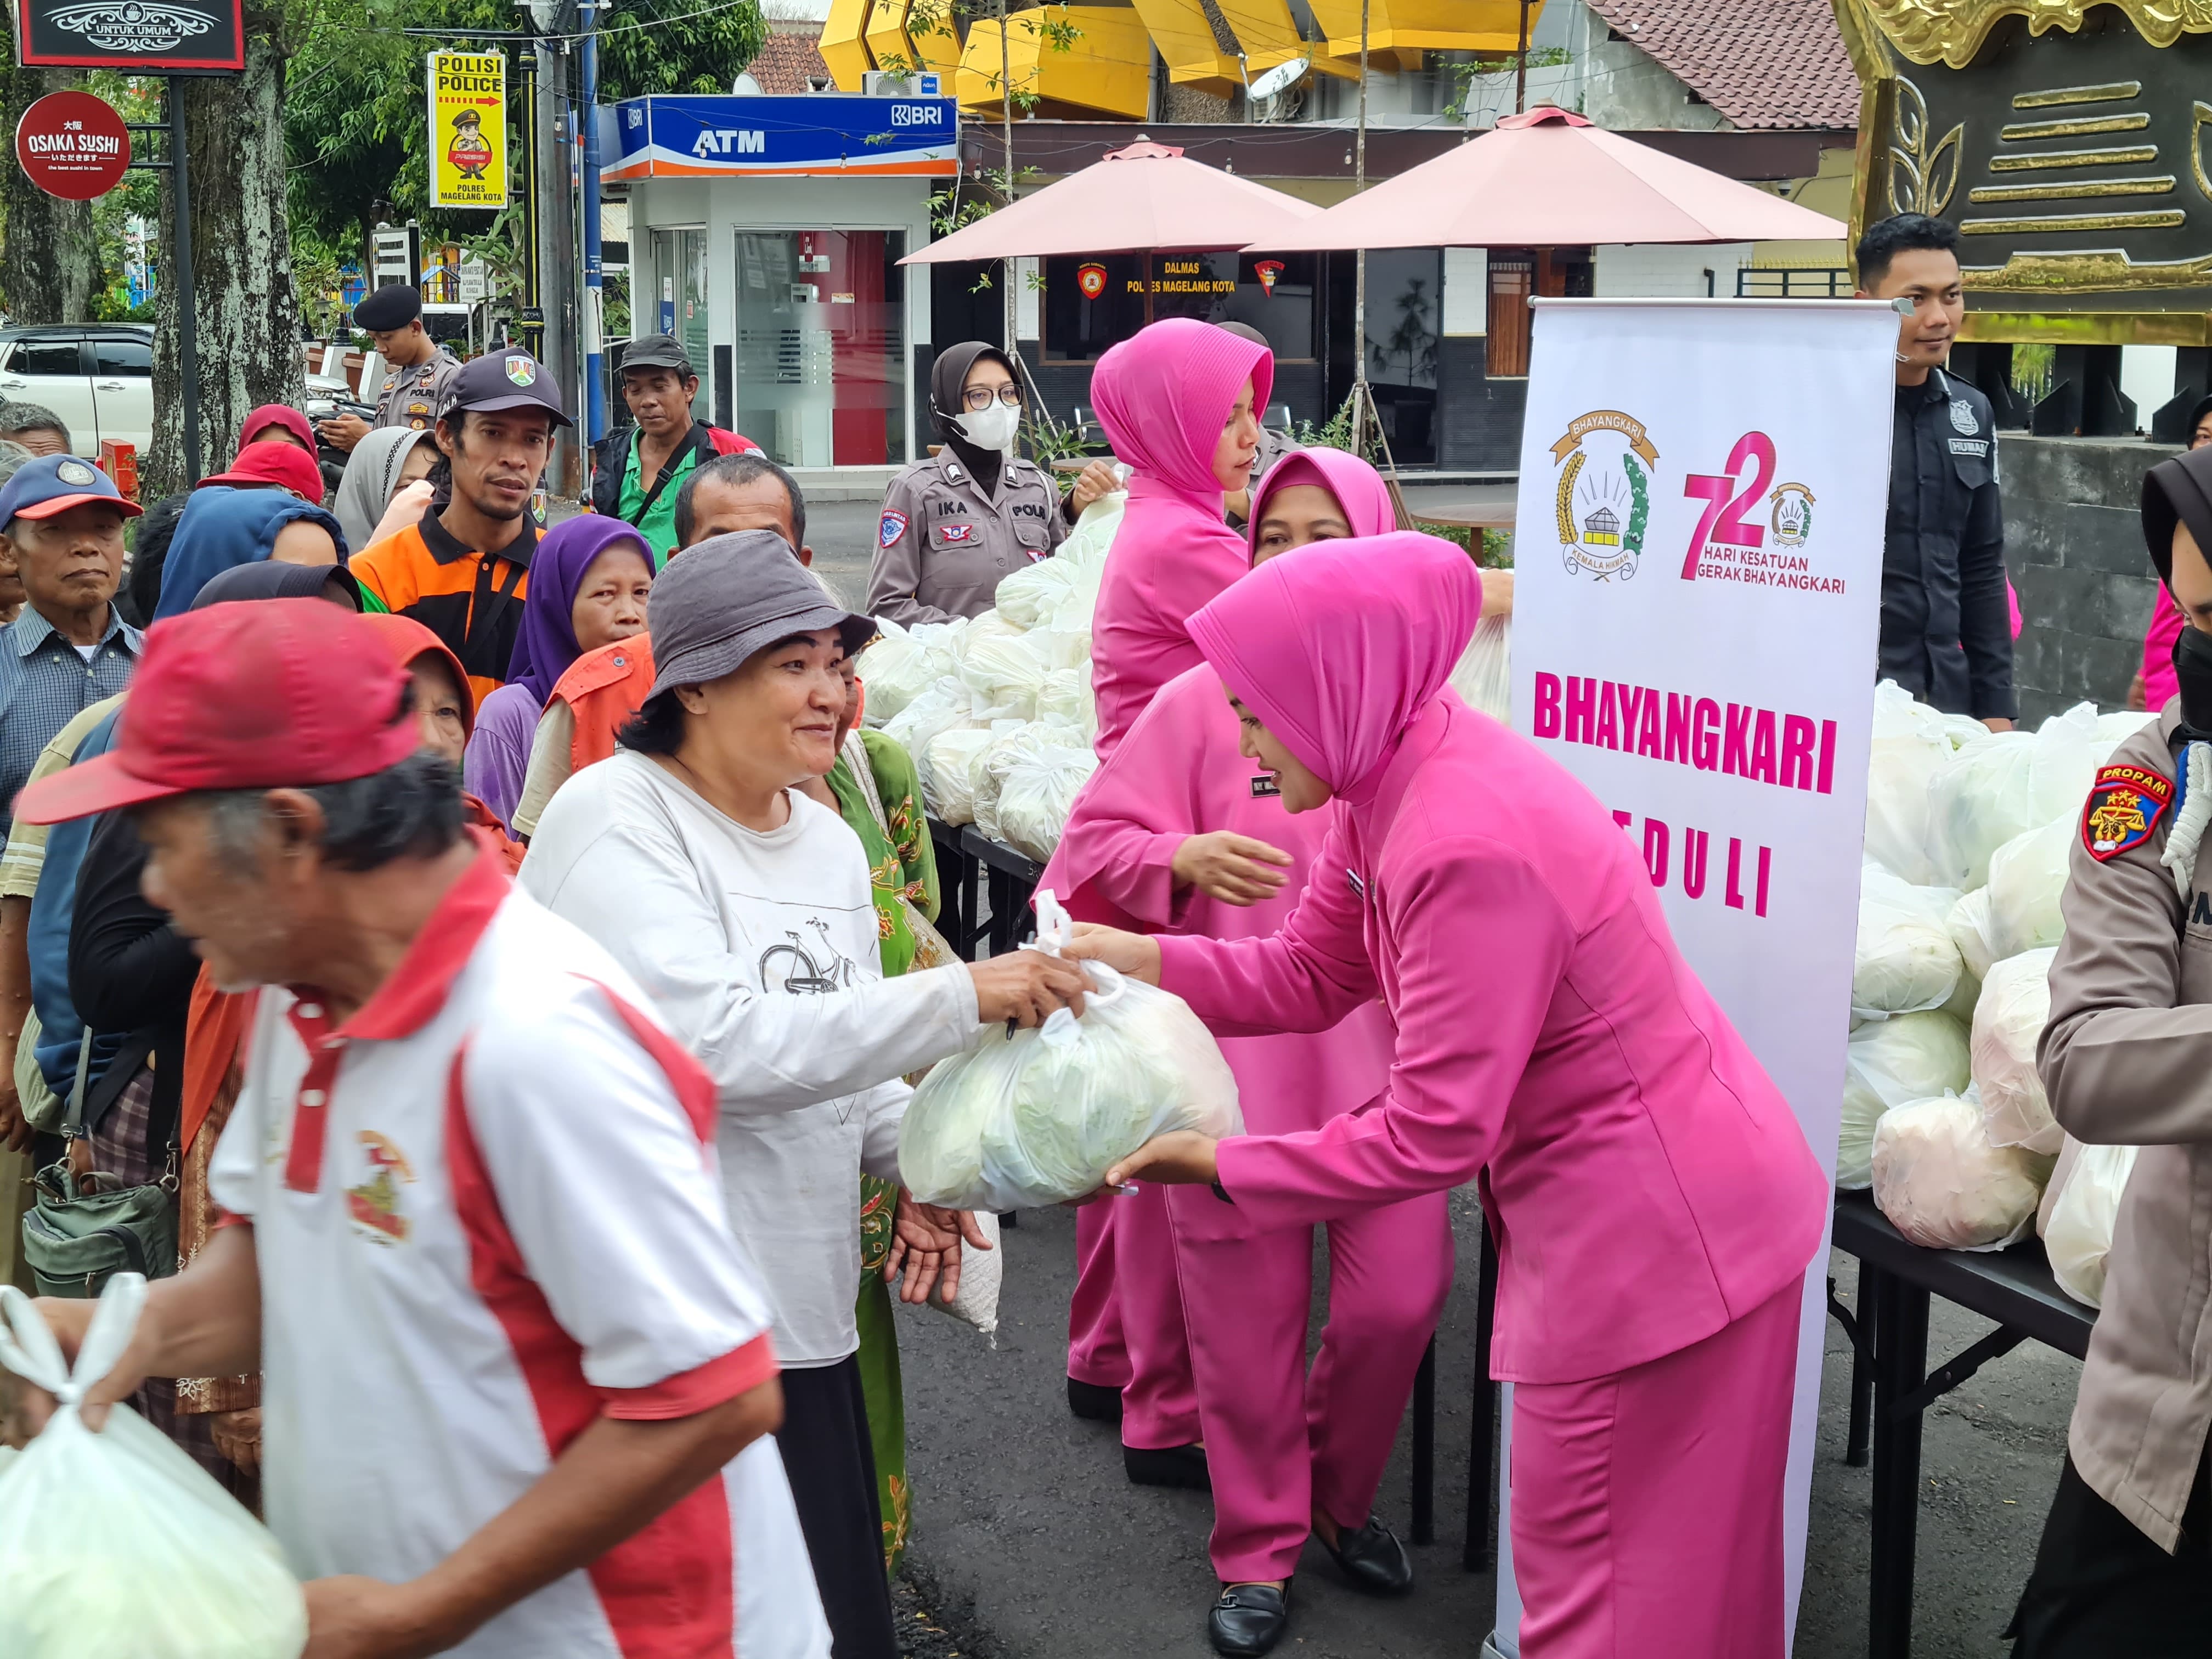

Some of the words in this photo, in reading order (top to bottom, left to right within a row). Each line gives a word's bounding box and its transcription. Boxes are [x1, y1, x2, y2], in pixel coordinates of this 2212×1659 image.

[96, 25, 134, 35] UNTUK
[137, 26, 171, 36] UMUM
[438, 57, 501, 73] POLISI
[438, 76, 501, 92] POLICE
[911, 106, 942, 125] BRI
[64, 121, 82, 131] 大阪
[28, 134, 75, 153] OSAKA
[78, 134, 119, 154] SUSHI
[692, 130, 765, 153] ATM
[51, 154, 98, 162] いただきます
[441, 191, 481, 201] MAGELANG
[483, 192, 502, 201] KOTA
[456, 184, 486, 193] POLRES
[1165, 262, 1200, 274] DALMAS
[1127, 280, 1161, 293] POLES
[1163, 280, 1210, 292] MAGELANG
[1212, 280, 1236, 293] KOTA
[410, 388, 435, 398] POLRI
[1573, 415, 1643, 439] BHAYANGKARI
[938, 501, 968, 516] IKA
[1572, 548, 1604, 569] KEMALA
[1605, 551, 1630, 570] HIKMAH
[1703, 545, 1737, 562] HARI
[1739, 550, 1809, 572] KESATUAN
[1697, 563, 1741, 582] GERAK
[1743, 567, 1846, 595] BHAYANGKARI
[1533, 670, 1838, 795] BHAYANGKARI
[2102, 768, 2167, 795] PROPAM
